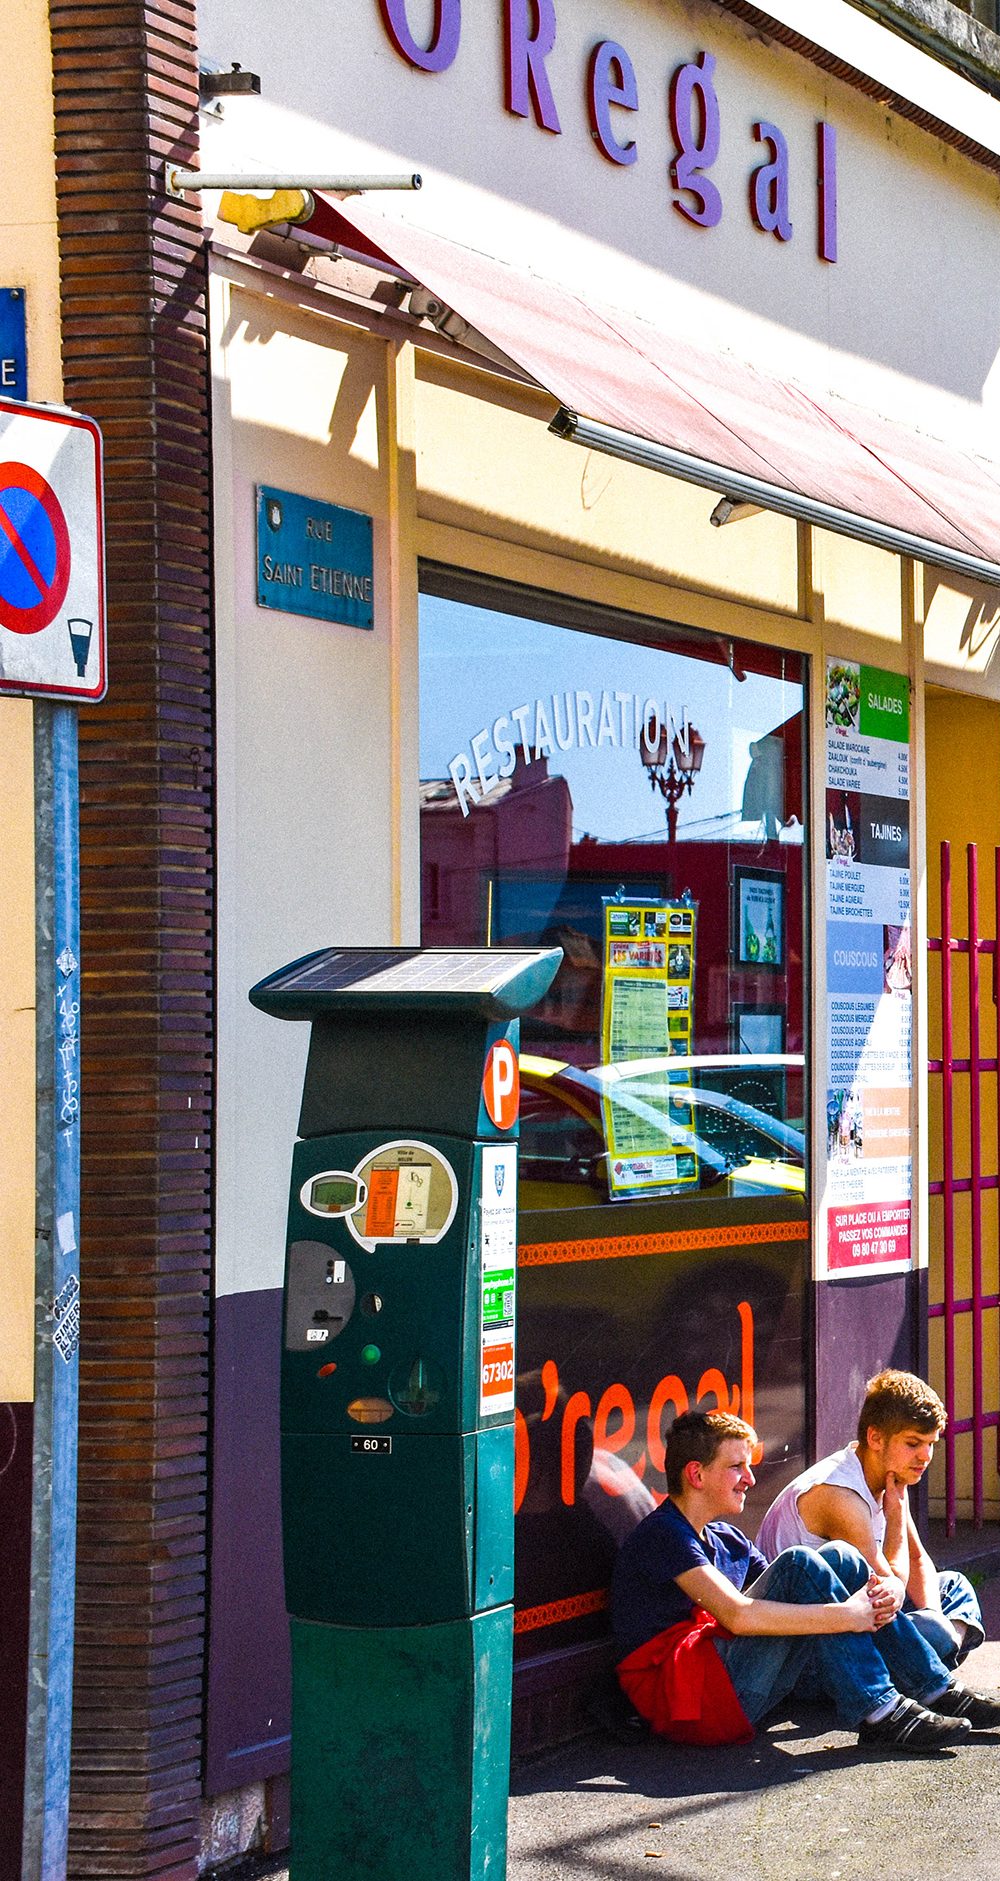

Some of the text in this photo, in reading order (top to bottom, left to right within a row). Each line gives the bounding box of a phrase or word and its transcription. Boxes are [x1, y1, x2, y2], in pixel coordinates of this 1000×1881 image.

[305, 517, 333, 542] RUE
[309, 564, 372, 603] ETIENNE
[868, 693, 903, 715] SALADES
[448, 690, 692, 819] RESTAURATION
[870, 823, 902, 842] TAJINES
[834, 950, 878, 967] COUSCOUS
[831, 1002, 854, 1010] COUSCOUS
[831, 1014, 854, 1022] COUSCOUS
[831, 1026, 854, 1034] COUSCOUS
[831, 1038, 854, 1047] COUSCOUS
[831, 1050, 854, 1059] COUSCOUS
[831, 1063, 854, 1071] COUSCOUS
[493, 1047, 514, 1123] P
[831, 1075, 854, 1083] COUSCOUS
[835, 1214, 847, 1227] SUR
[848, 1212, 867, 1225] PLACE
[868, 1211, 876, 1224] OU
[882, 1208, 910, 1222] EMPORTER
[838, 1224, 908, 1243] PASSEZ VOS COMMANDES
[852, 1243, 861, 1257] 09
[871, 1241, 878, 1255] 47
[483, 1360, 514, 1384] 67302
[363, 1440, 378, 1450] 60
